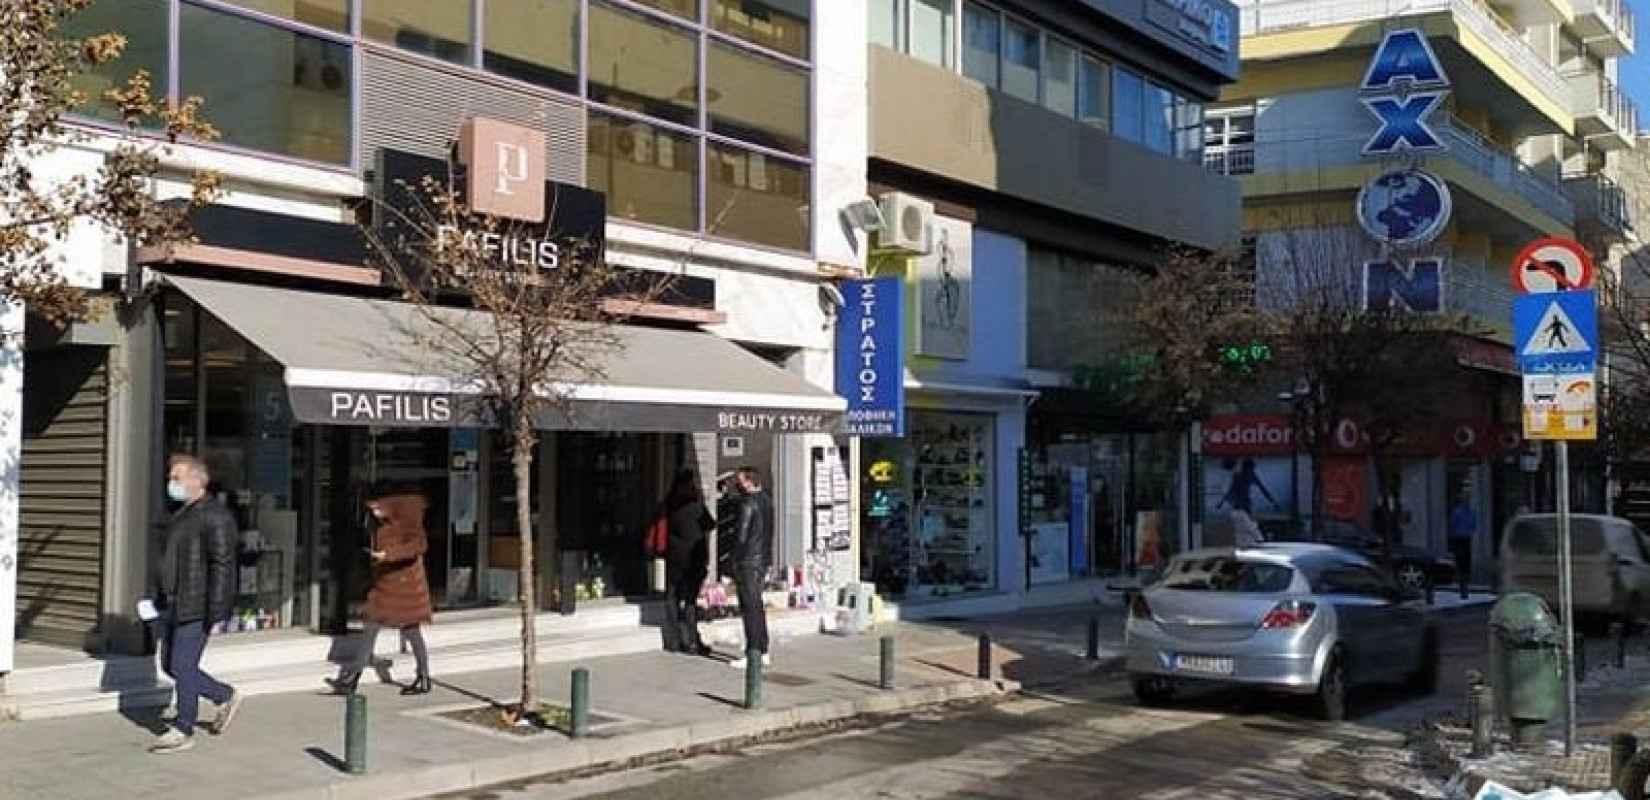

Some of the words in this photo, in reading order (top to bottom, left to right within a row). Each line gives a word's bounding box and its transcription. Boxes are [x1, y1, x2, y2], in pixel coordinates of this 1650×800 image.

[860, 283, 877, 403] ΣΤΡΑΤΟΣ
[331, 392, 451, 422] PAFILIS
[718, 411, 776, 429] BEAUTY
[780, 414, 824, 431] STORE
